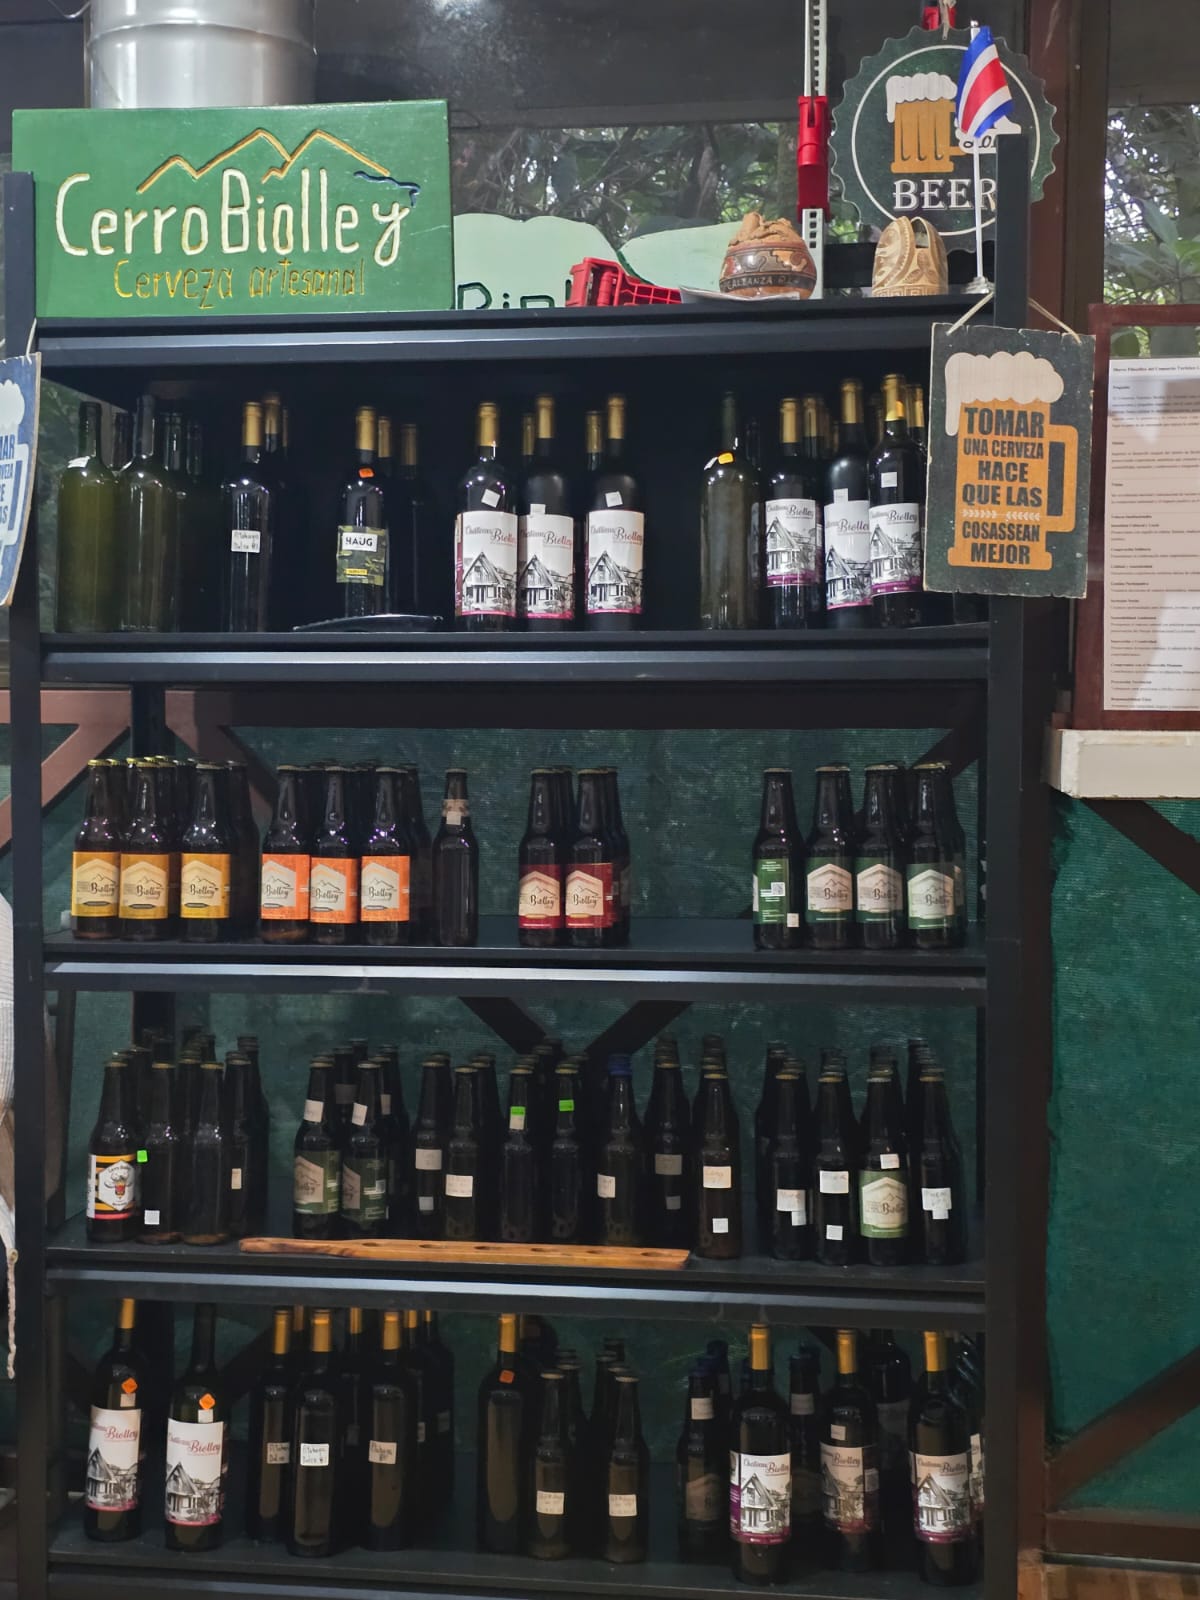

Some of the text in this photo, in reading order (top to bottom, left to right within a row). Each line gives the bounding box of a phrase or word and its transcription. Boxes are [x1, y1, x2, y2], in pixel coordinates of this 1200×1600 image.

[892, 177, 998, 212] BEER
[113, 258, 365, 309] Cerveza artesanal
[964, 407, 1045, 438] TOMAR
[963, 438, 1044, 459] UNA CERVEZA
[978, 460, 1029, 483] HACE
[962, 483, 1043, 507] QUE LAS
[970, 543, 1031, 565] MEJOR
